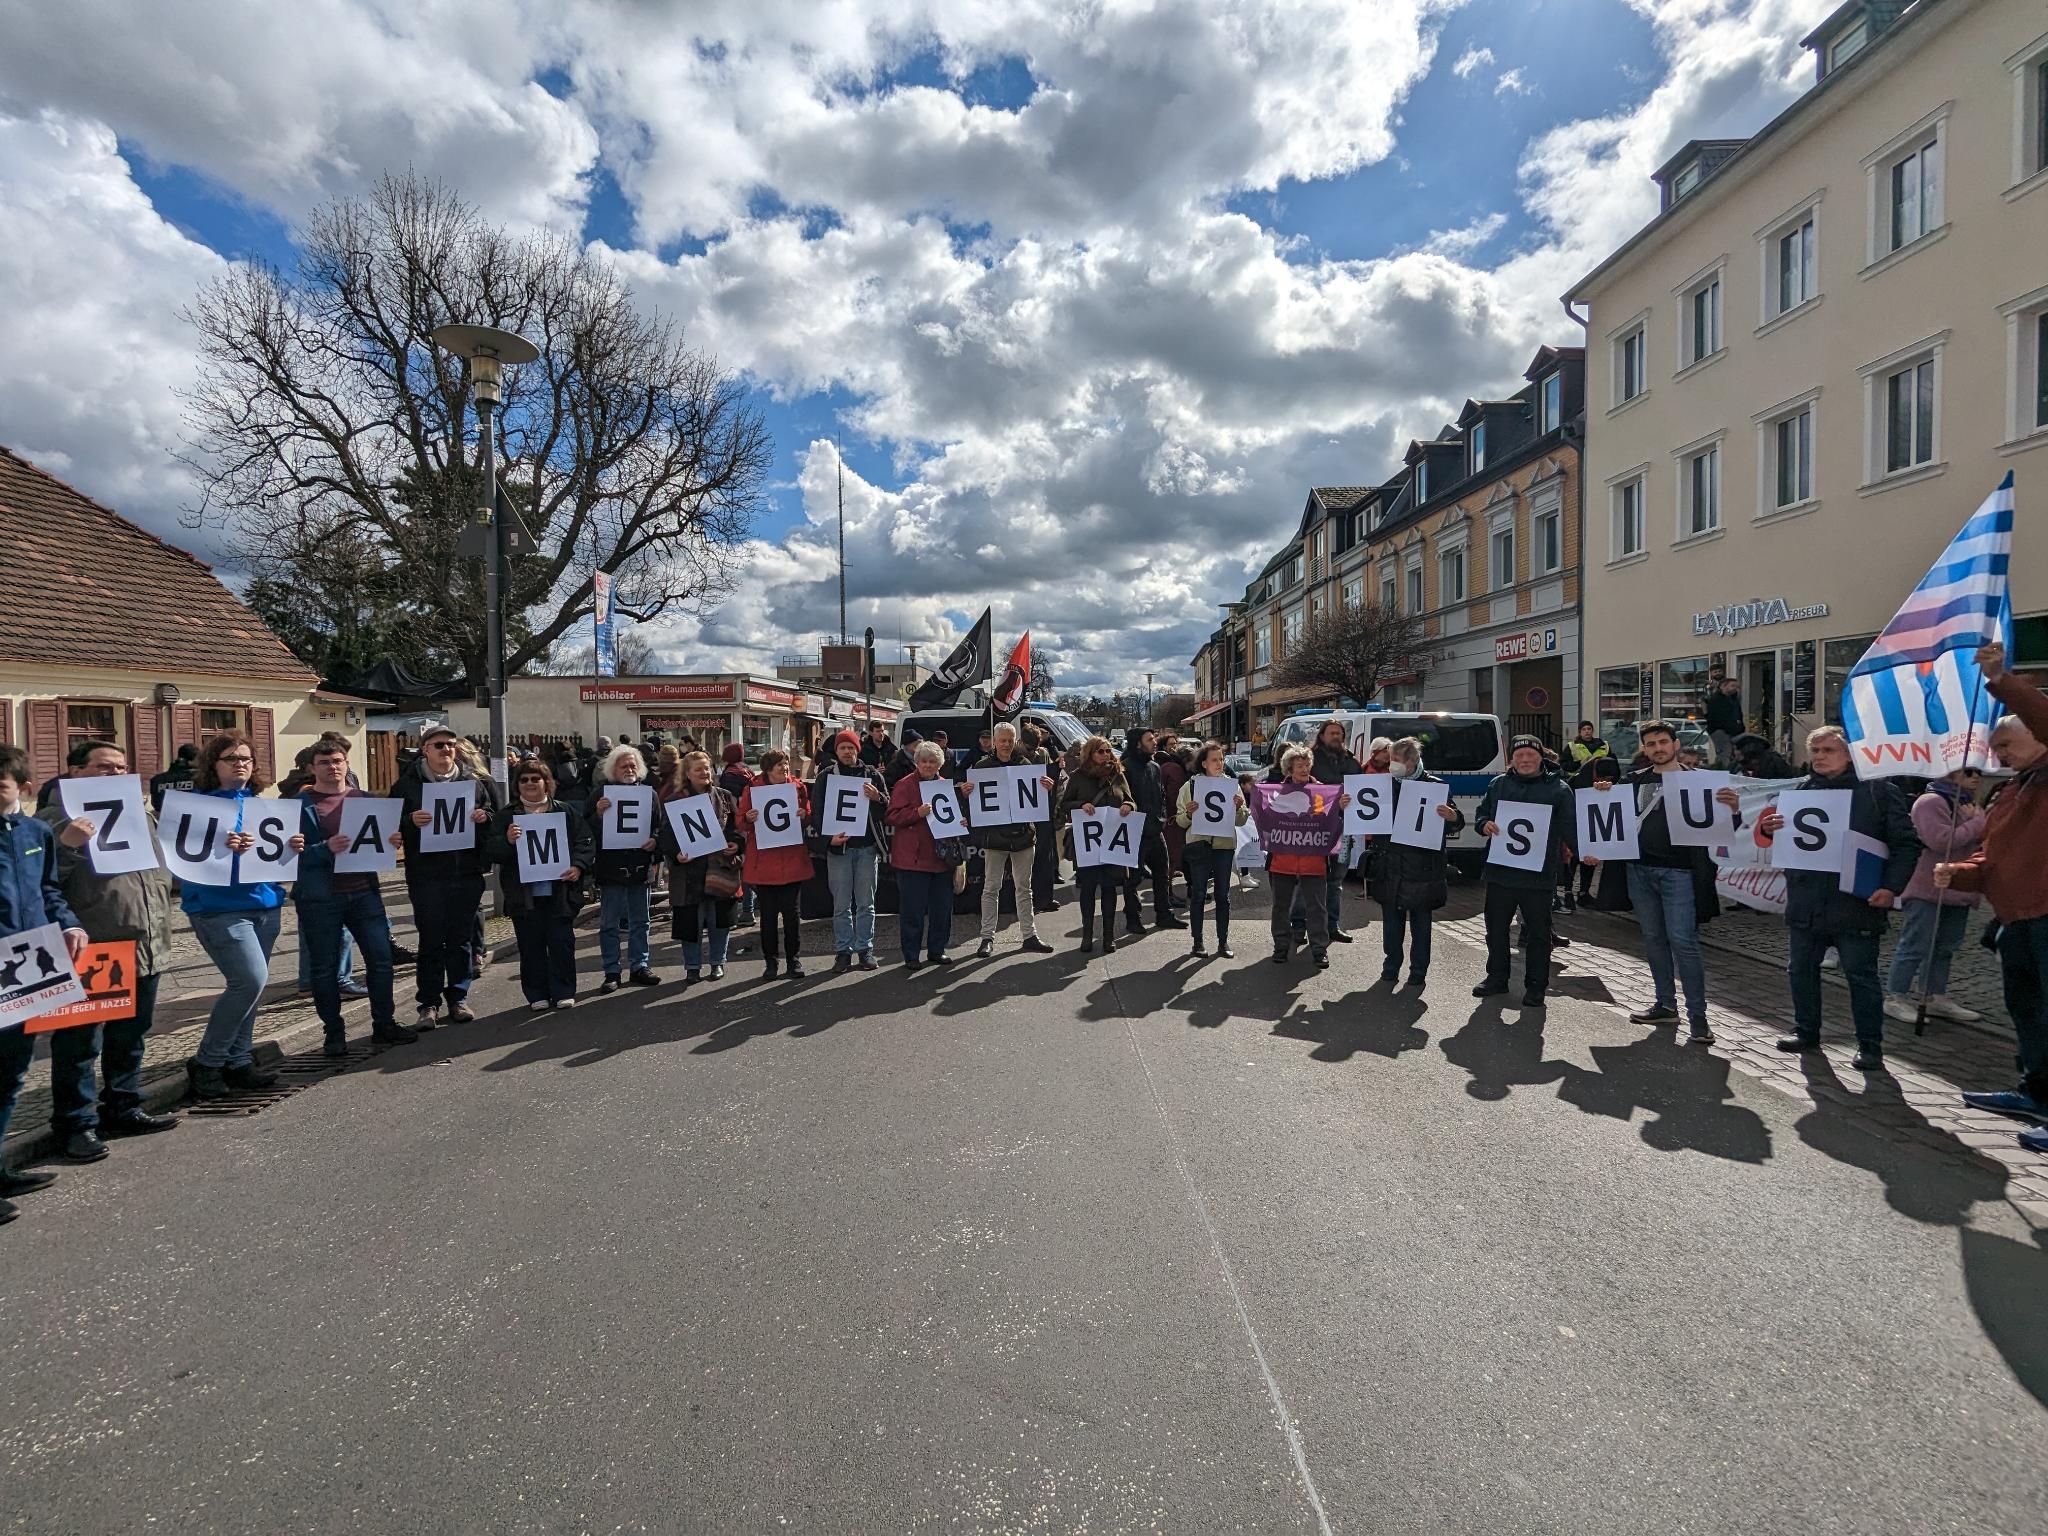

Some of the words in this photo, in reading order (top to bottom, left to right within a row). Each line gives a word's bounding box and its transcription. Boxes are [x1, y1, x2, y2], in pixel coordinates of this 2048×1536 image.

[1788, 604, 1825, 621] FRISEUR
[1496, 637, 1526, 658] REWE
[1546, 631, 1554, 649] P
[582, 690, 636, 700] Birkhölzer
[650, 685, 662, 694] Ihr
[664, 684, 729, 694] Raumausstatter
[1860, 742, 1932, 765] VVN
[158, 781, 195, 793] POLIZEI
[978, 780, 1000, 813] E
[1017, 777, 1039, 809] N
[432, 796, 466, 836] M
[616, 799, 640, 834] E
[763, 798, 791, 833] G
[835, 789, 859, 823] E
[931, 793, 956, 824] G
[1204, 790, 1226, 823] S
[1356, 787, 1380, 821] S
[1679, 788, 1715, 829] U
[83, 799, 130, 852] Z
[175, 813, 219, 863] U
[348, 814, 385, 855] A
[679, 808, 712, 844] N
[1082, 820, 1104, 852] R
[1107, 822, 1131, 855] A
[1270, 828, 1331, 847] COURAGE
[1506, 818, 1535, 856] S
[1587, 801, 1625, 843] M
[1792, 807, 1830, 852] S
[256, 817, 285, 863] S
[525, 828, 560, 866] M
[1, 997, 34, 1013] GEGEN
[40, 982, 77, 1001] NAZIS
[71, 1002, 96, 1014] GEGEN
[101, 998, 132, 1009] NAZIS
